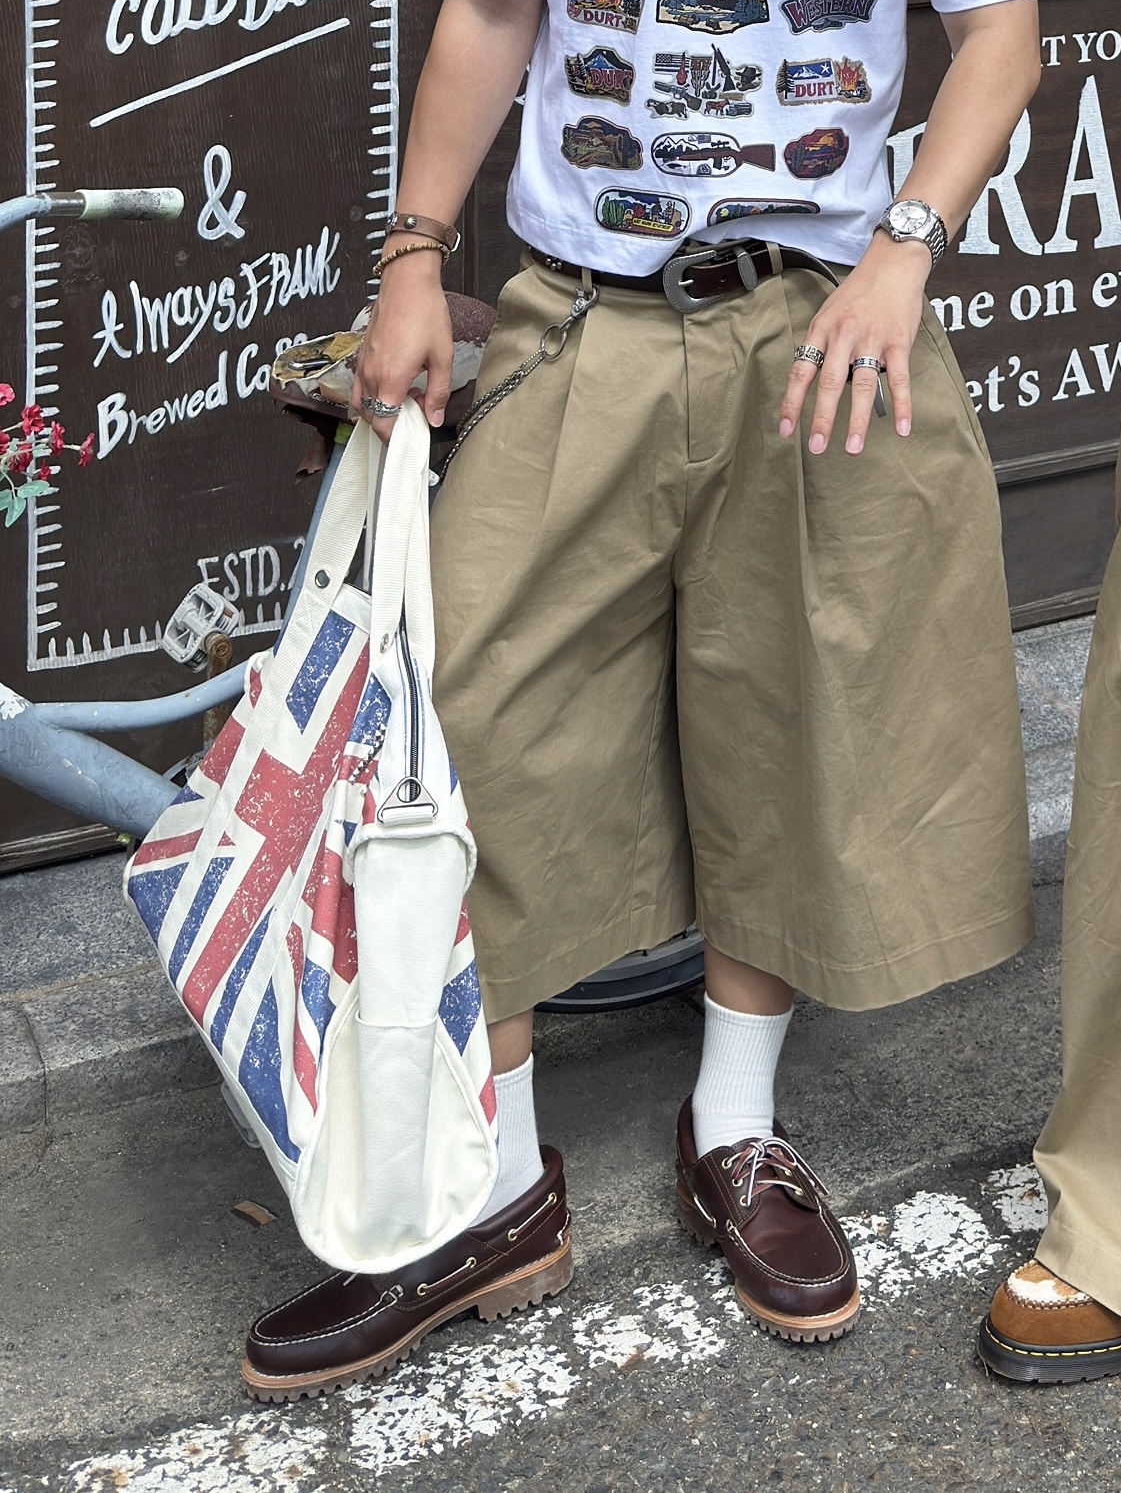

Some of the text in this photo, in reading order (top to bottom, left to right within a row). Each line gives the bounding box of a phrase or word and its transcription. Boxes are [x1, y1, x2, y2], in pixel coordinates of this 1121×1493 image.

[583, 9, 623, 27] DURT
[795, 80, 835, 98] DURT
[197, 145, 248, 241] &
[93, 226, 341, 367] Always FRANK
[1009, 278, 1077, 321] on
[96, 350, 229, 460] Brewed
